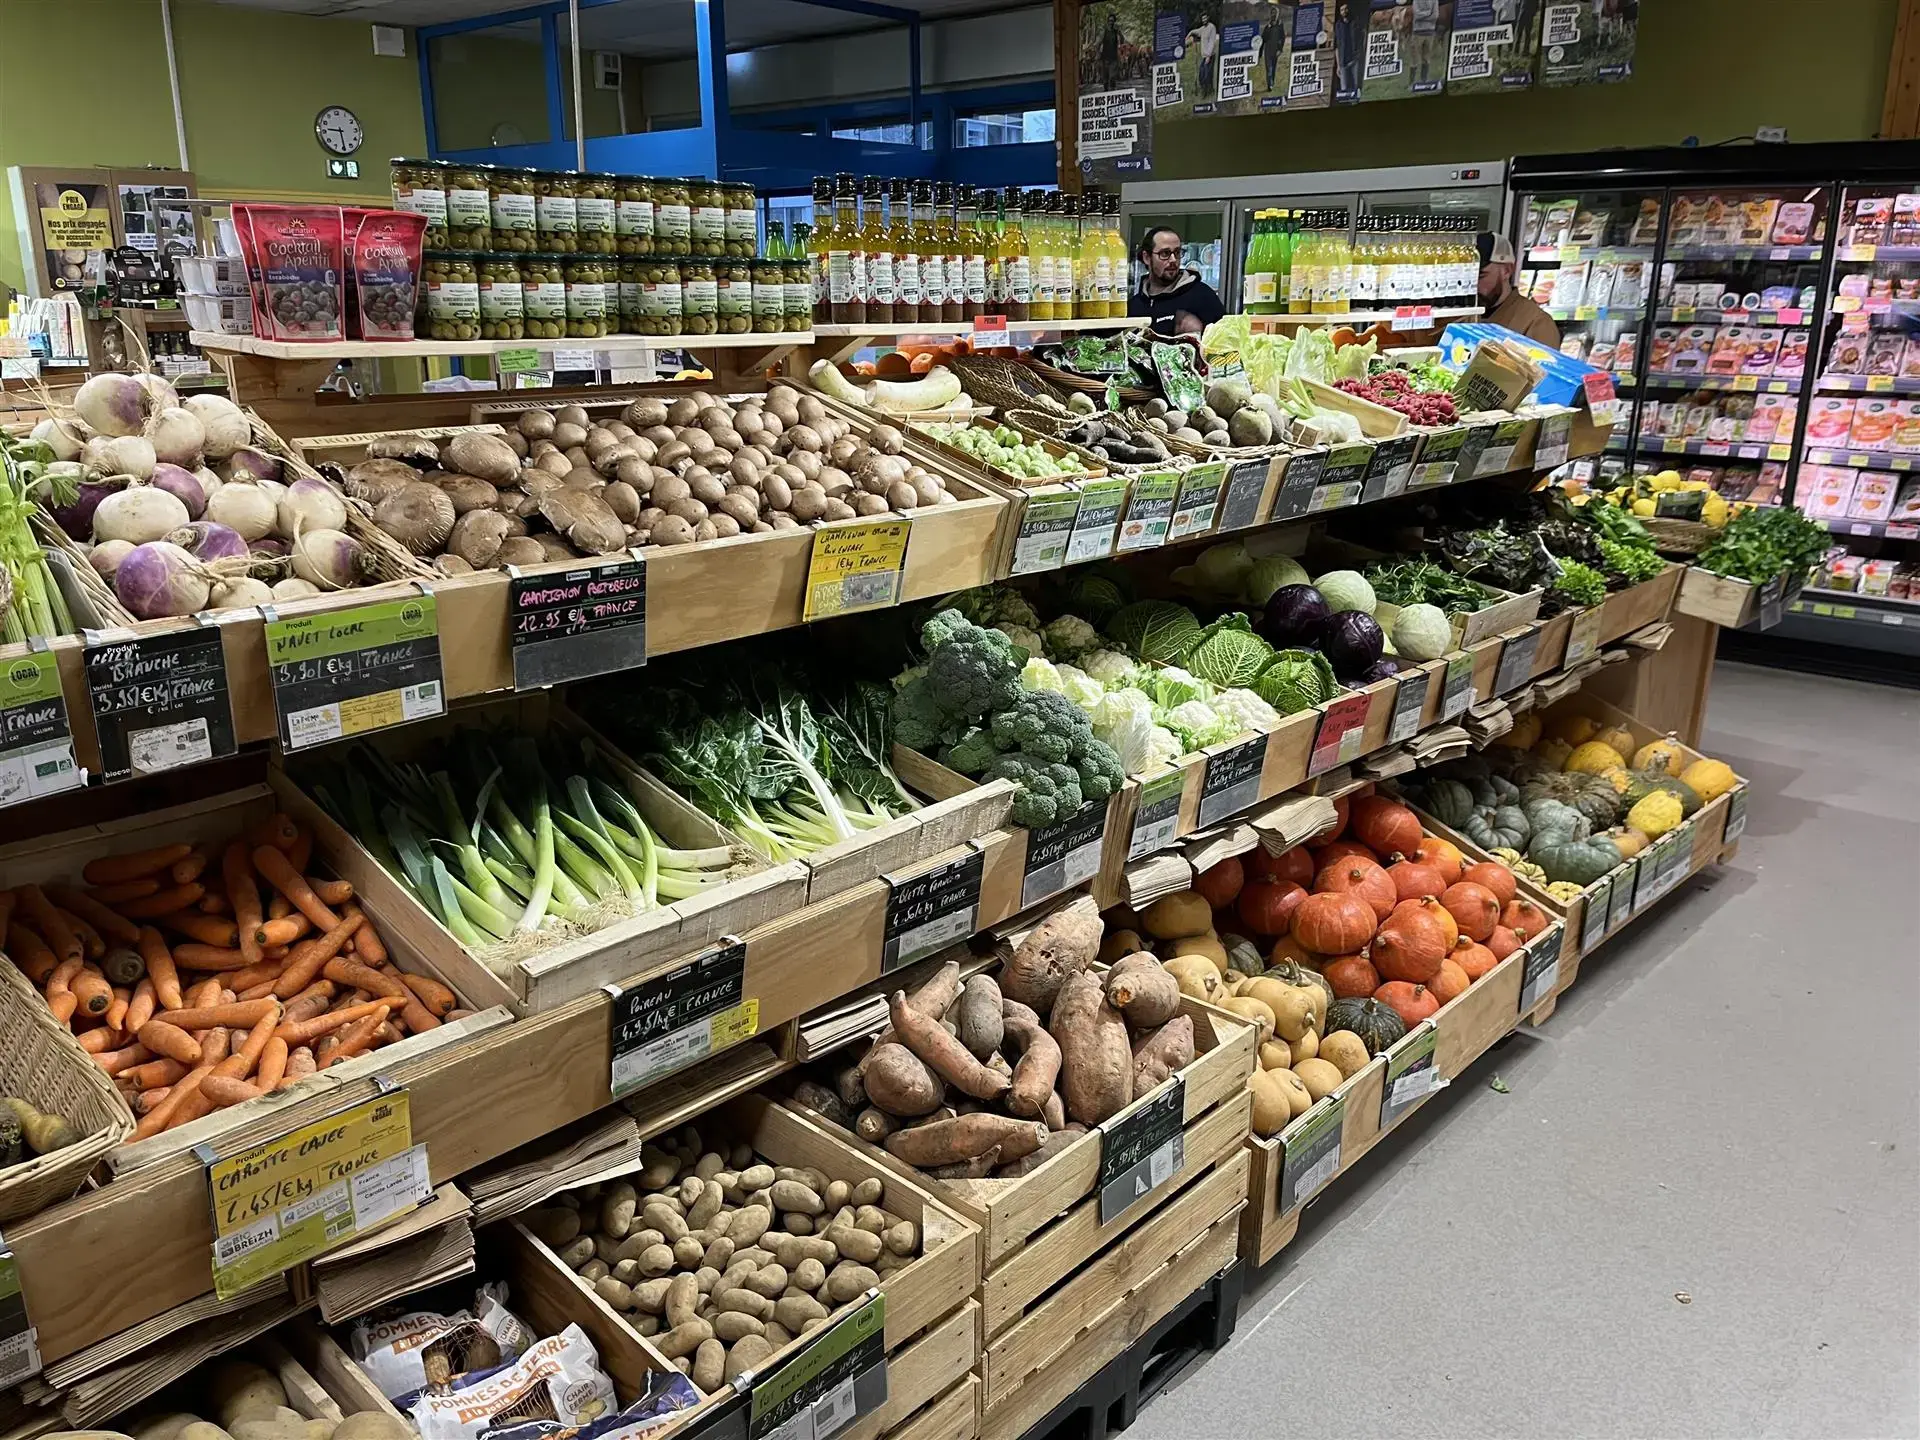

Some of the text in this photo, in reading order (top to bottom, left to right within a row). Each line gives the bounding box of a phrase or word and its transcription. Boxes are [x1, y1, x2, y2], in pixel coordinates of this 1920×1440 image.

[1478, 32, 1486, 41] ET
[1369, 44, 1395, 54] PAYSAN
[1453, 44, 1483, 54] PAYSANS
[1223, 67, 1244, 77] PAYSAN
[1081, 93, 1133, 108] AVEC NOS PAYSANS
[1081, 119, 1119, 131] NOUS FAISONS
[1081, 131, 1100, 142] BOUGER
[1101, 131, 1112, 140] LES
[47, 220, 61, 228] Nos
[63, 220, 76, 229] prix
[268, 239, 321, 256] Cocktail
[285, 619, 312, 630] Produit
[276, 632, 320, 652] NAVET
[11, 667, 39, 682] LOCAL
[173, 679, 215, 699] FRANCE
[686, 980, 733, 1011] FRANCE
[235, 1149, 265, 1165] Produit
[359, 1173, 380, 1185] France
[367, 1315, 437, 1345] POMMES
[500, 1319, 516, 1341] CHAIR
[431, 1385, 499, 1414] POMMES
[502, 1371, 524, 1389] DE
[521, 1335, 571, 1375] TERRE
[566, 1383, 590, 1402] CHAIR
[568, 1389, 594, 1412] FERME
